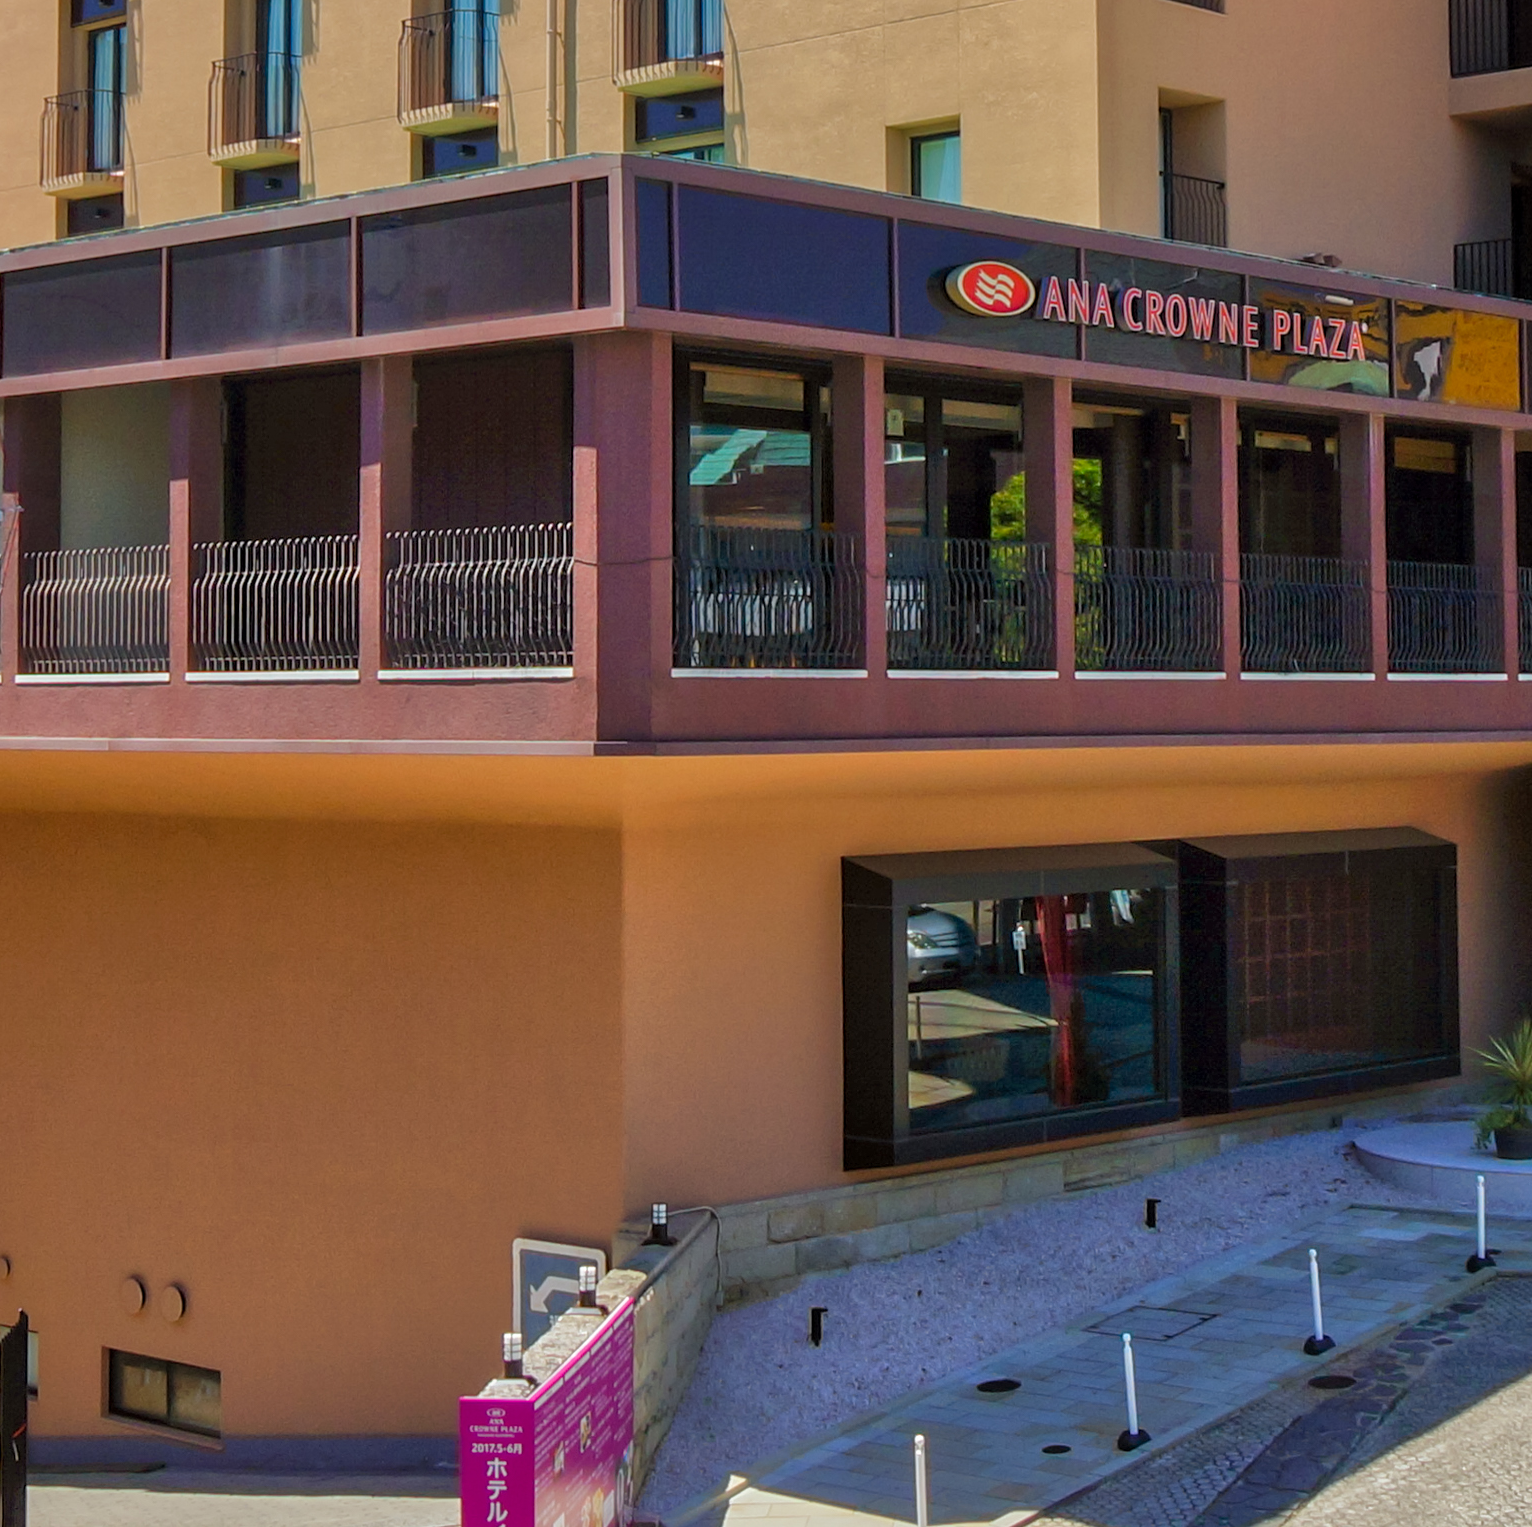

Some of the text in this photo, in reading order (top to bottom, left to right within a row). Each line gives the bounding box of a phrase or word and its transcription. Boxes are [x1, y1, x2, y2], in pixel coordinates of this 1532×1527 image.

[1042, 275, 1366, 362] ANA CROWNE PLAZA
[500, 1426, 523, 1434] PLAZA
[486, 1457, 509, 1527] ホテル
